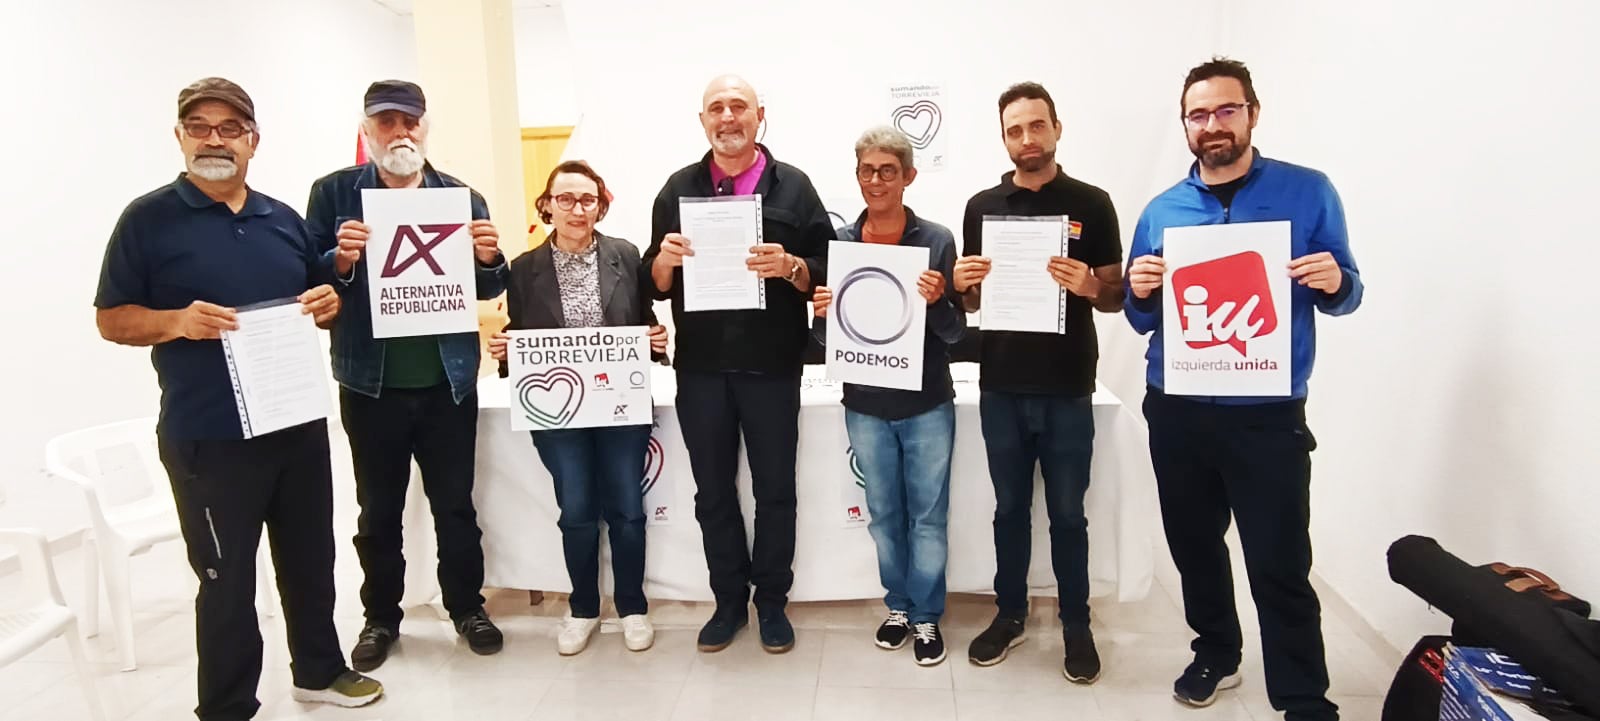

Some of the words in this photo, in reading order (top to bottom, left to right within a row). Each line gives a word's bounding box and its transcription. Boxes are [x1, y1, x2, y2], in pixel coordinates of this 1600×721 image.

[380, 284, 464, 301] ALTERNATIVA
[380, 298, 466, 316] REPUBLICANA
[517, 347, 640, 365] TORREVIEJA
[835, 349, 909, 369] PODEMOS
[1171, 358, 1231, 372] izquierda
[1234, 358, 1278, 370] unida
